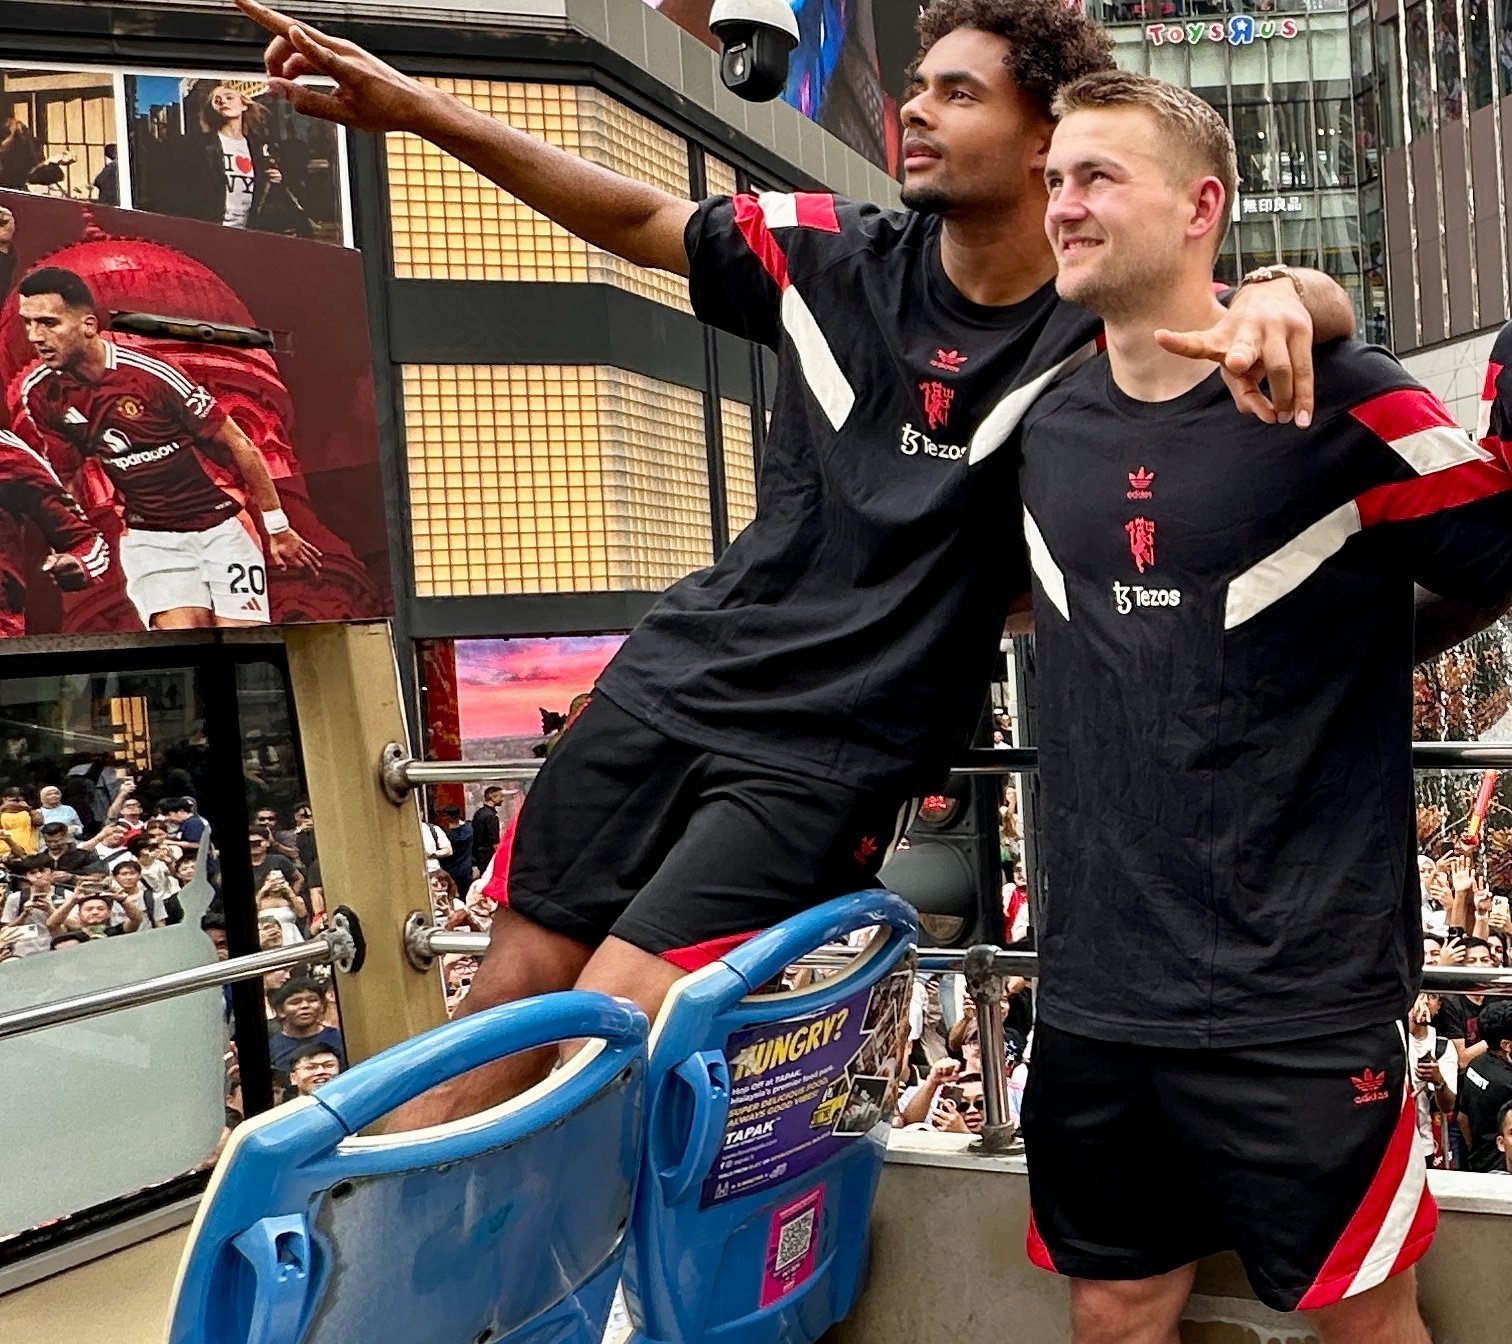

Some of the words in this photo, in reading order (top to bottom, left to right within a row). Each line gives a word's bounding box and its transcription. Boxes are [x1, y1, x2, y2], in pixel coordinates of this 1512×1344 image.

[223, 154, 234, 172] I
[1243, 197, 1302, 213] 無印良品
[227, 563, 266, 596] 20
[1132, 585, 1181, 607] Tezos
[730, 1008, 849, 1082] HUNGRY?
[724, 1120, 775, 1145] TAPAK
